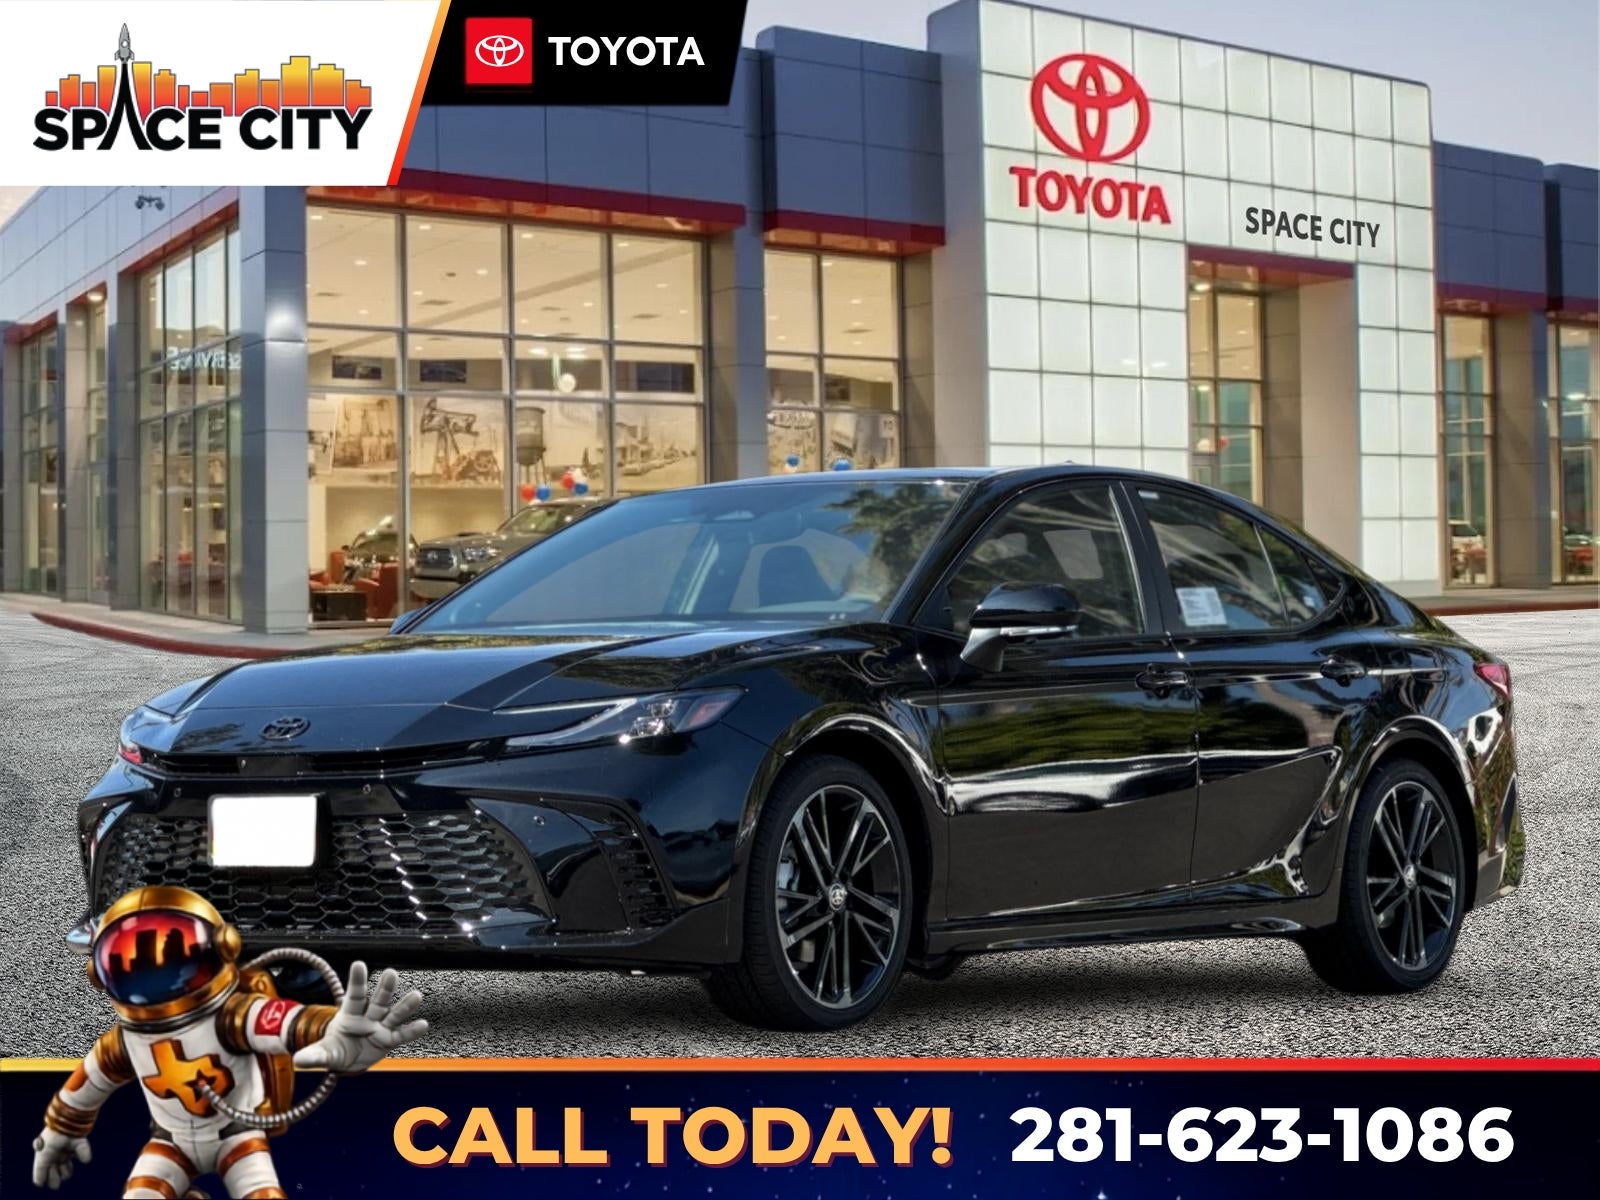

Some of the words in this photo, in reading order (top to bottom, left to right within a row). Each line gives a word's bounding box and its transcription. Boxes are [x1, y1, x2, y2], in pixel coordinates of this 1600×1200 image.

[1010, 166, 1170, 224] TOYOTA
[1245, 206, 1322, 242] SPACE
[1329, 218, 1380, 248] CITY
